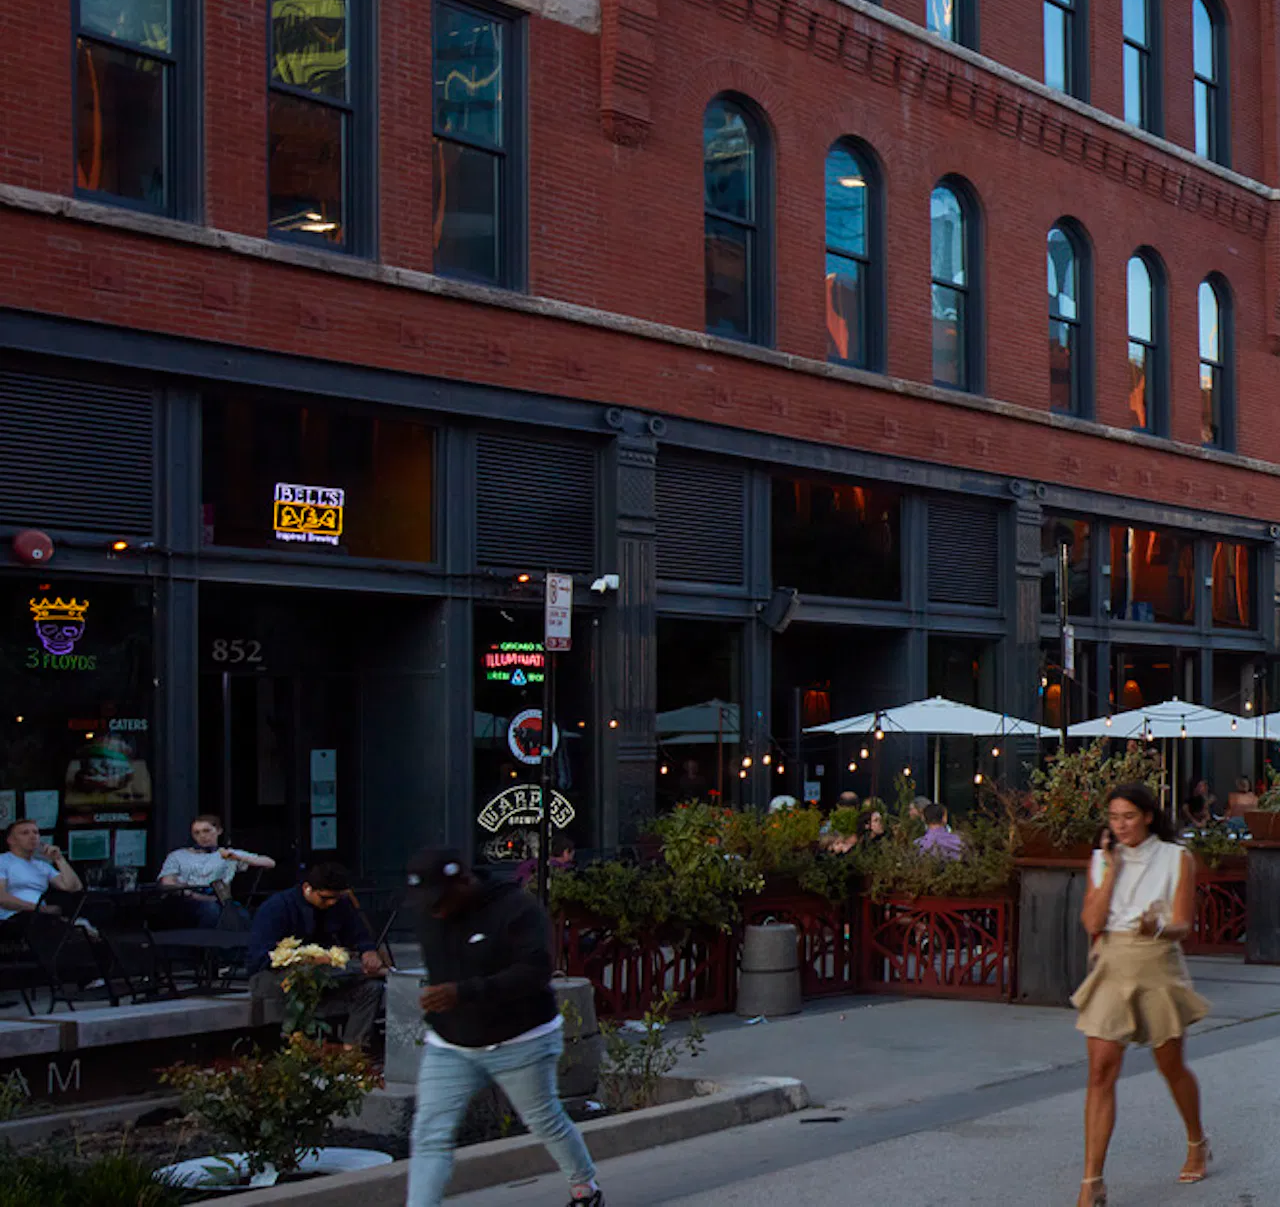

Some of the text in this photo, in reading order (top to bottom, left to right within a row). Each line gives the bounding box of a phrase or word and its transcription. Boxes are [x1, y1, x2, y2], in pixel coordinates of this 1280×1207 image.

[211, 638, 263, 664] 852
[42, 654, 97, 671] FLOYDS
[109, 718, 149, 731] CATERS
[480, 788, 571, 827] WARPGS
